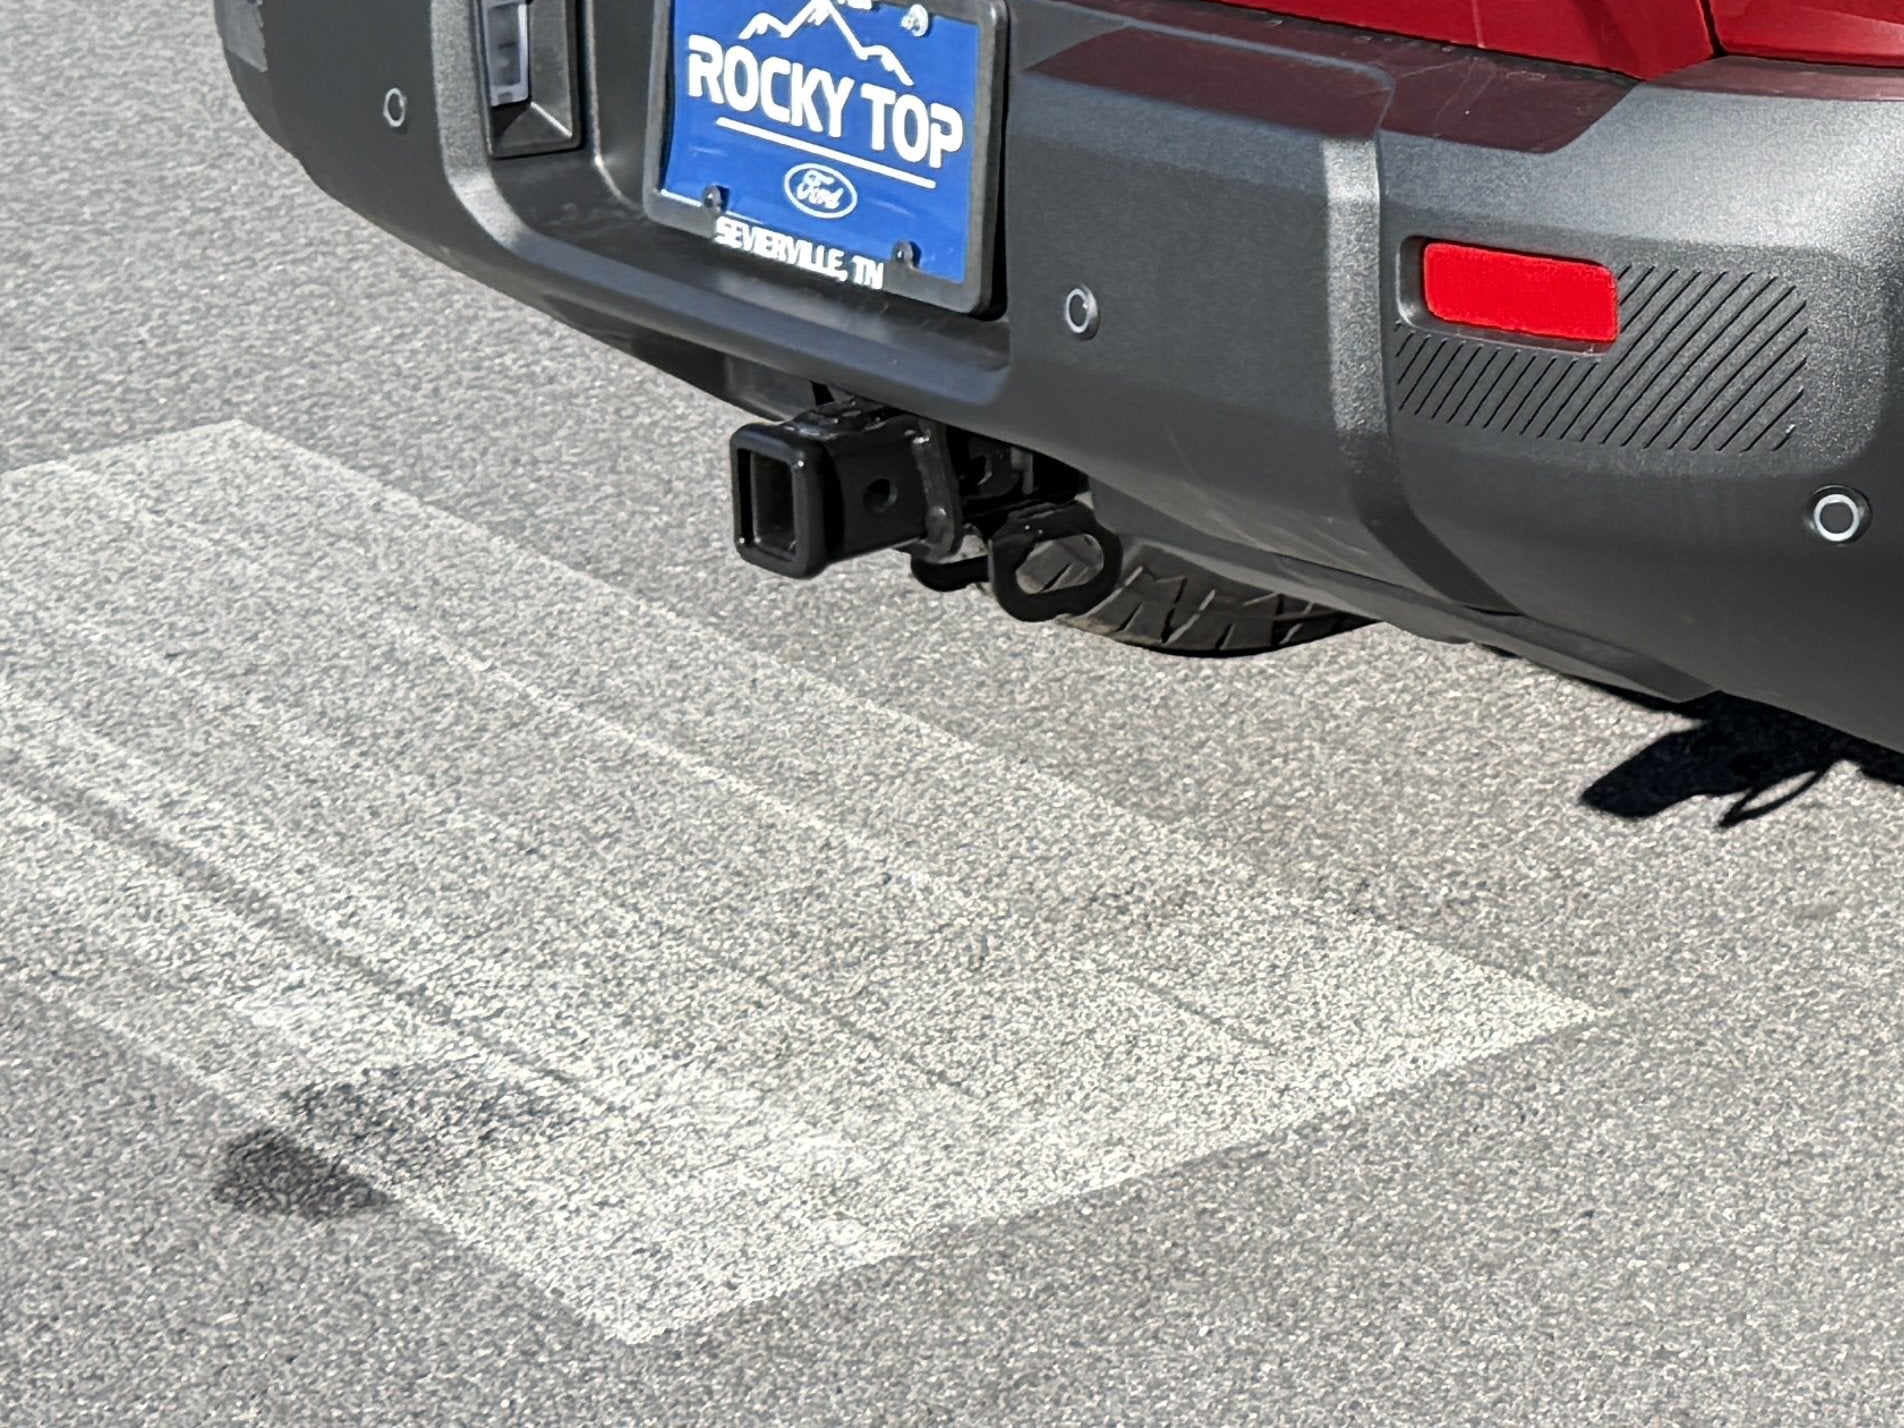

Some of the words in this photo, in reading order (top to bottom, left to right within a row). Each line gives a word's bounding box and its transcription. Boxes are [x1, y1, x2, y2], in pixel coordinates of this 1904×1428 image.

[688, 33, 855, 138] ROCKY
[860, 82, 964, 169] TOP
[796, 169, 845, 210] Ford
[850, 255, 885, 290] TN
